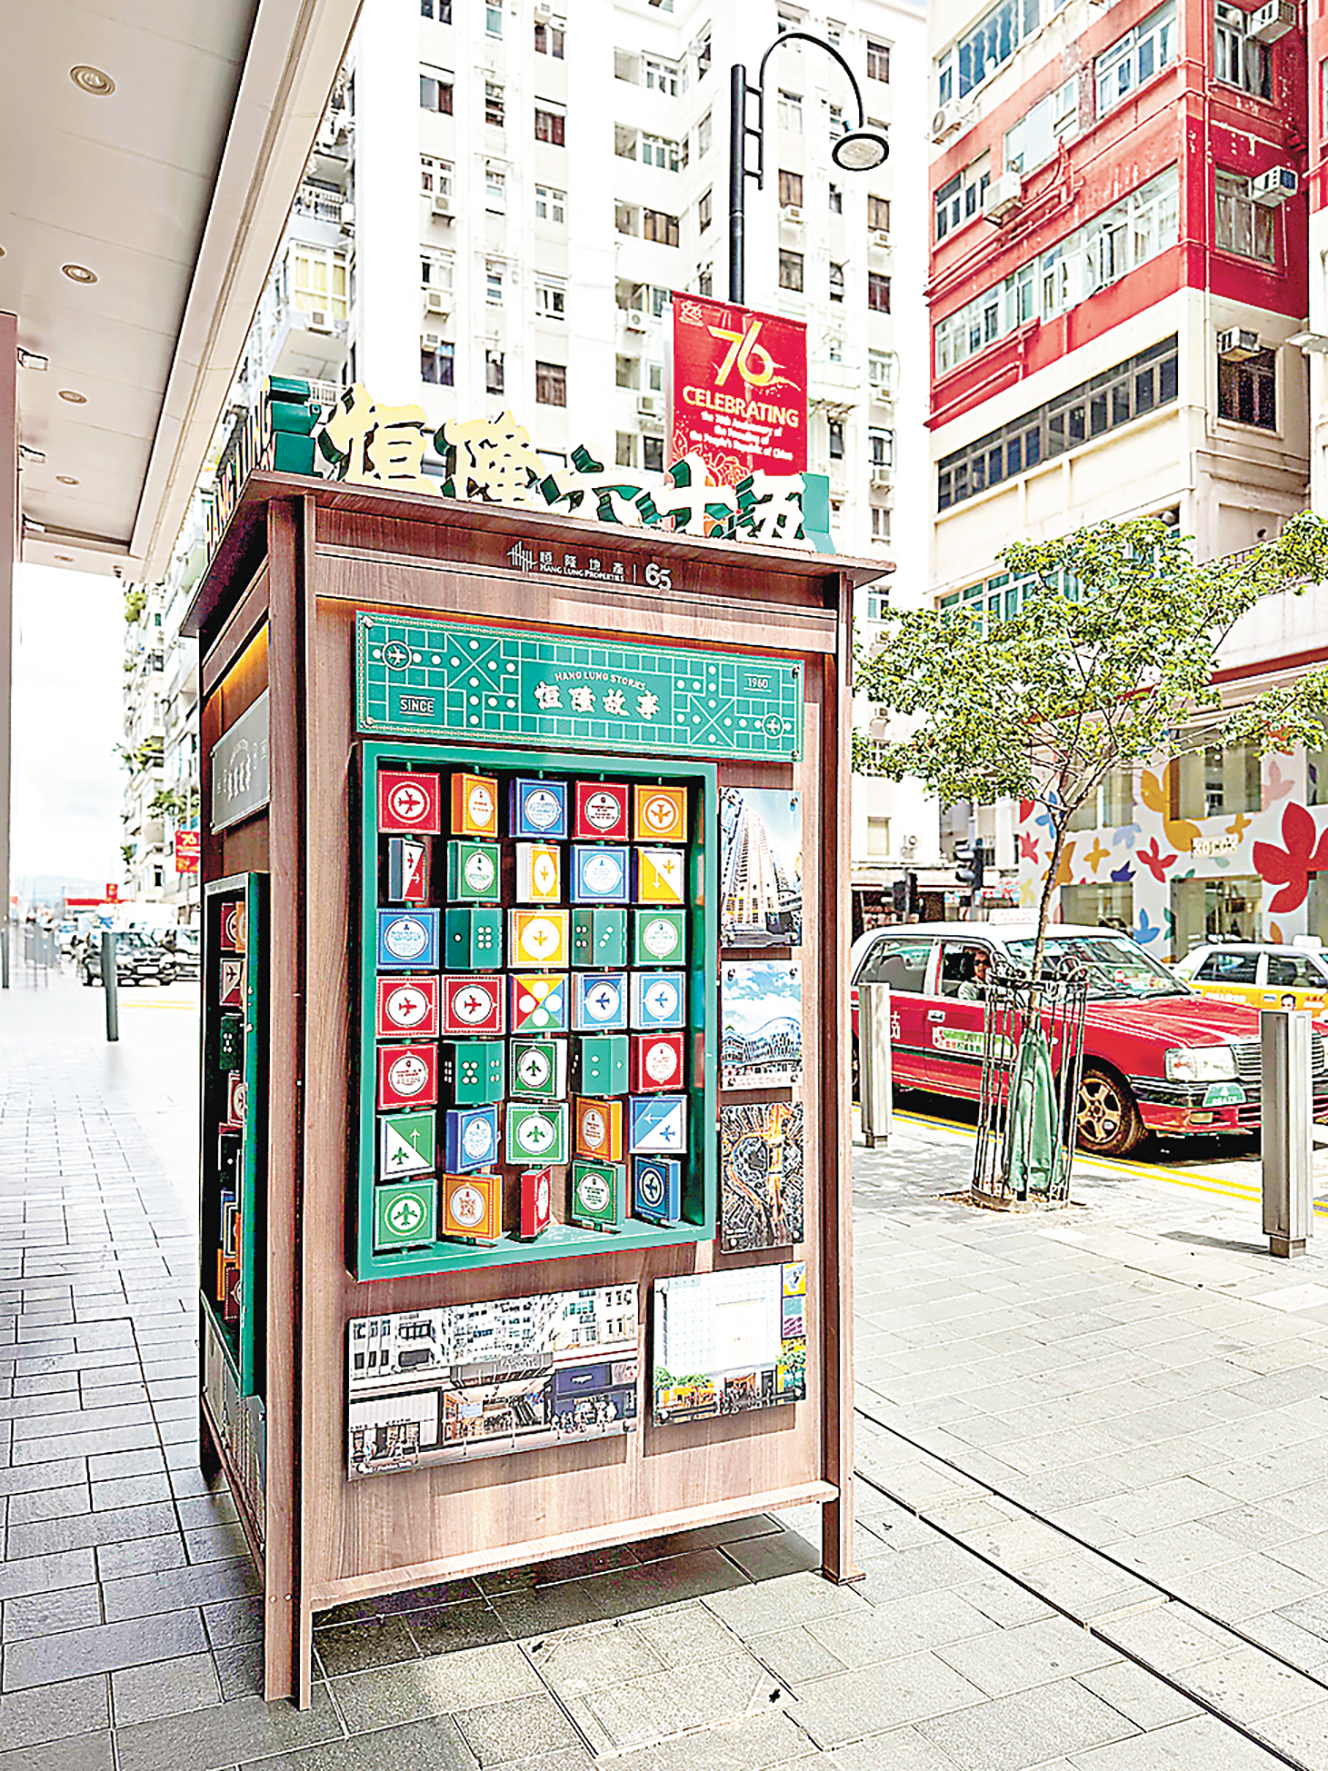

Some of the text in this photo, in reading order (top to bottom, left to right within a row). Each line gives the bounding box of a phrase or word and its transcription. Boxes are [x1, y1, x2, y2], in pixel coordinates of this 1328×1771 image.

[707, 321, 784, 390] 76
[683, 385, 799, 428] CELEBRATING
[325, 382, 806, 551] 恒隆六十五
[539, 563, 562, 574] HANG
[563, 566, 584, 577] LUNG
[645, 563, 672, 590] 65
[555, 671, 646, 690] HANG LUNG STORIES
[748, 677, 768, 688] 1960
[400, 699, 434, 713] SINCE
[533, 681, 661, 720] 恒隆故事
